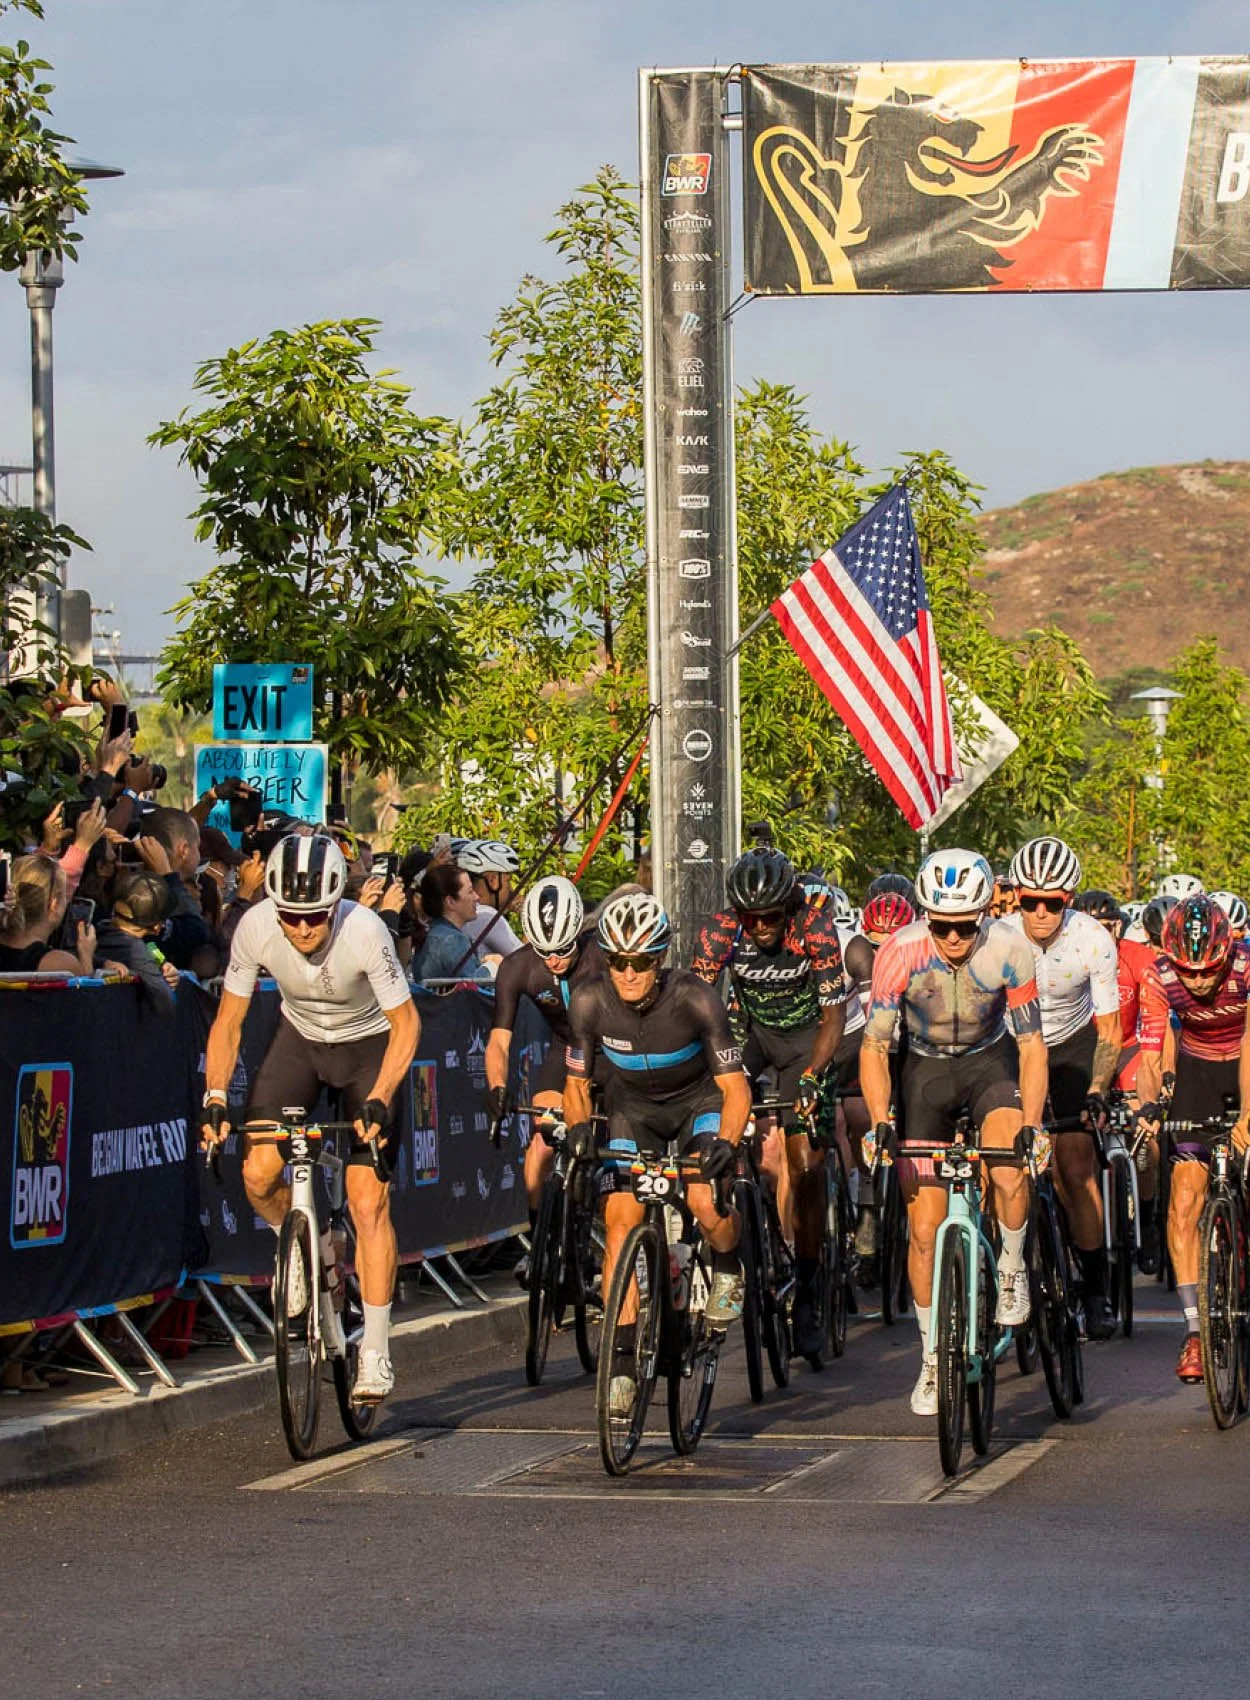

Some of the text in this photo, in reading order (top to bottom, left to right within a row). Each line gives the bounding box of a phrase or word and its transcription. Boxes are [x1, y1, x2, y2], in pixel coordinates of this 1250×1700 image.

[665, 176, 705, 192] BWR
[664, 253, 712, 262] CANYON
[678, 375, 705, 388] ELIEL
[676, 408, 709, 417] wahoo
[223, 685, 288, 731] EXIT
[202, 750, 306, 772] ABSOLUTELY
[246, 775, 310, 805] BEER
[292, 1139, 309, 1155] 3
[636, 1175, 670, 1195] 20
[14, 1165, 62, 1225] BWR
